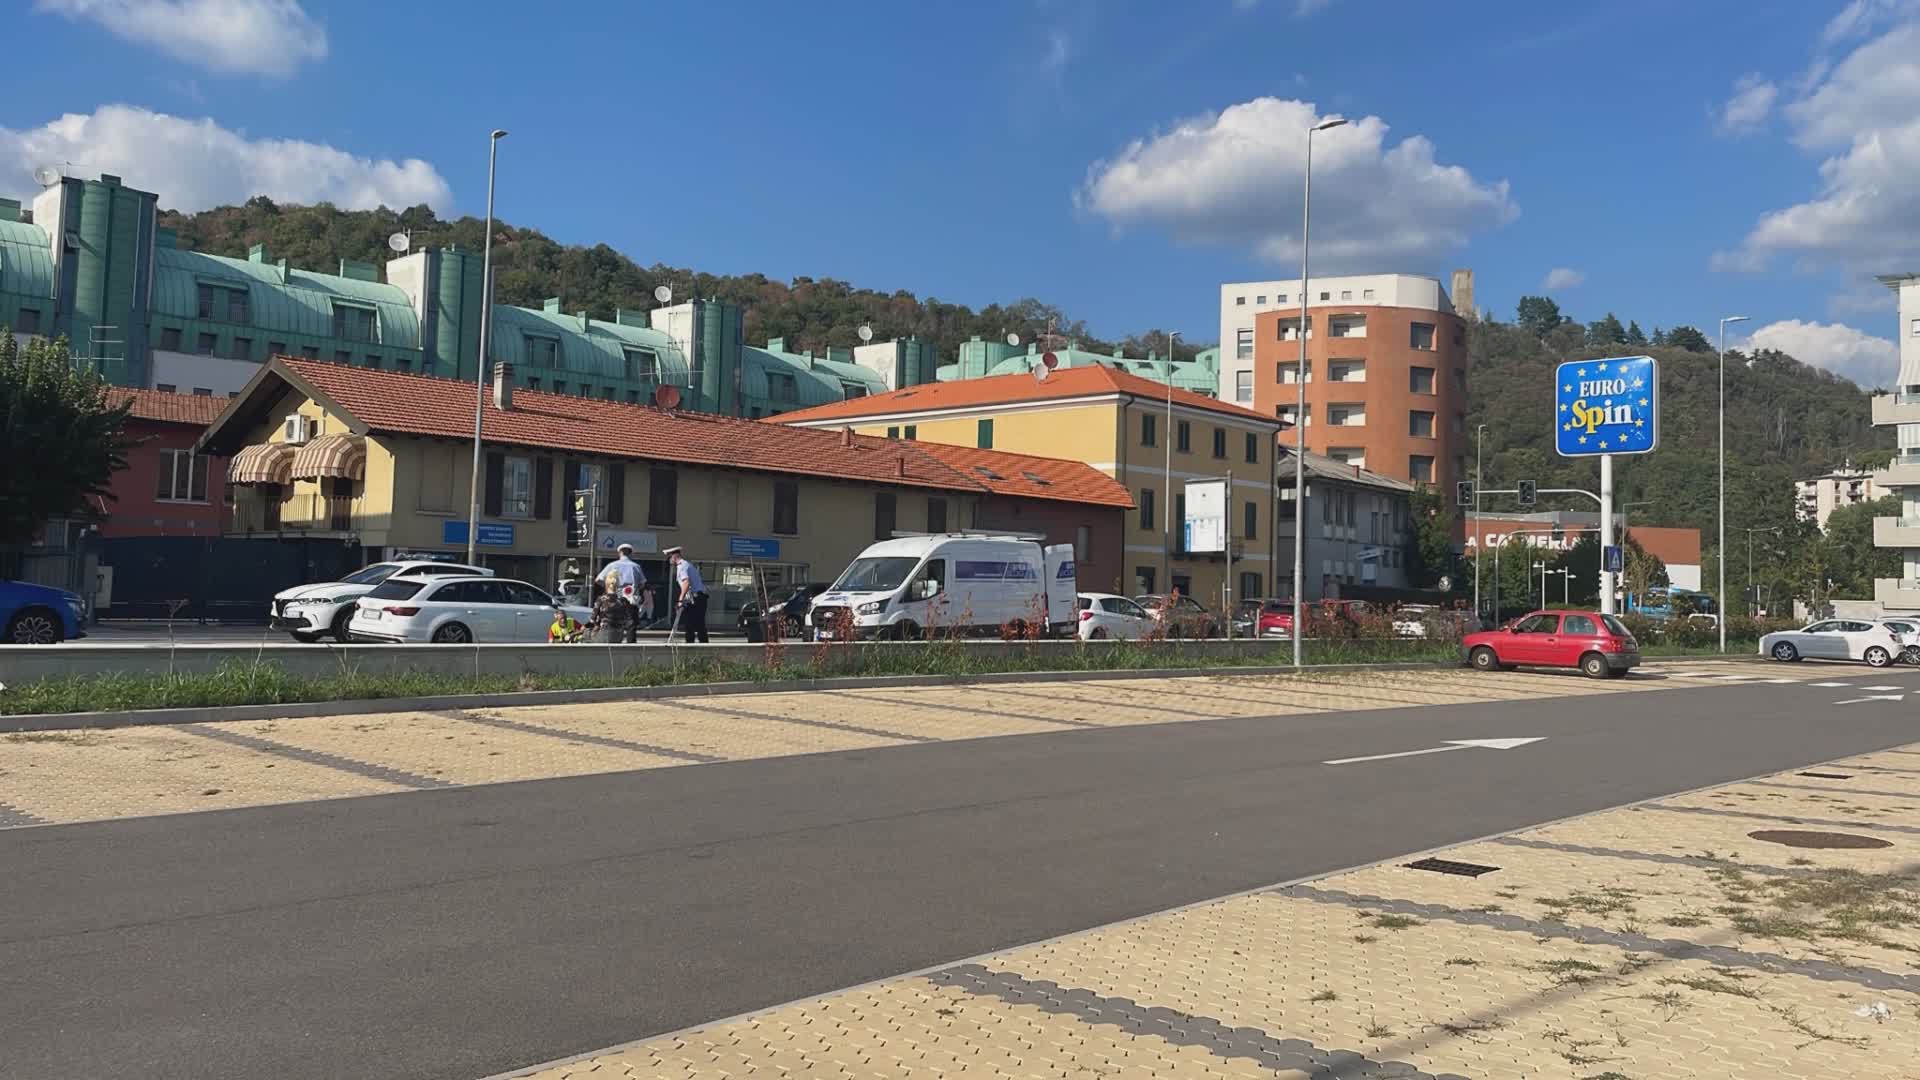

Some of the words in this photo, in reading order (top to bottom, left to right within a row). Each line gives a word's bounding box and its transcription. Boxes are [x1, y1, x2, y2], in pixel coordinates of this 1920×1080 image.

[1579, 378, 1626, 398] EURO
[1571, 399, 1633, 434] Spin
[1465, 536, 1477, 547] A
